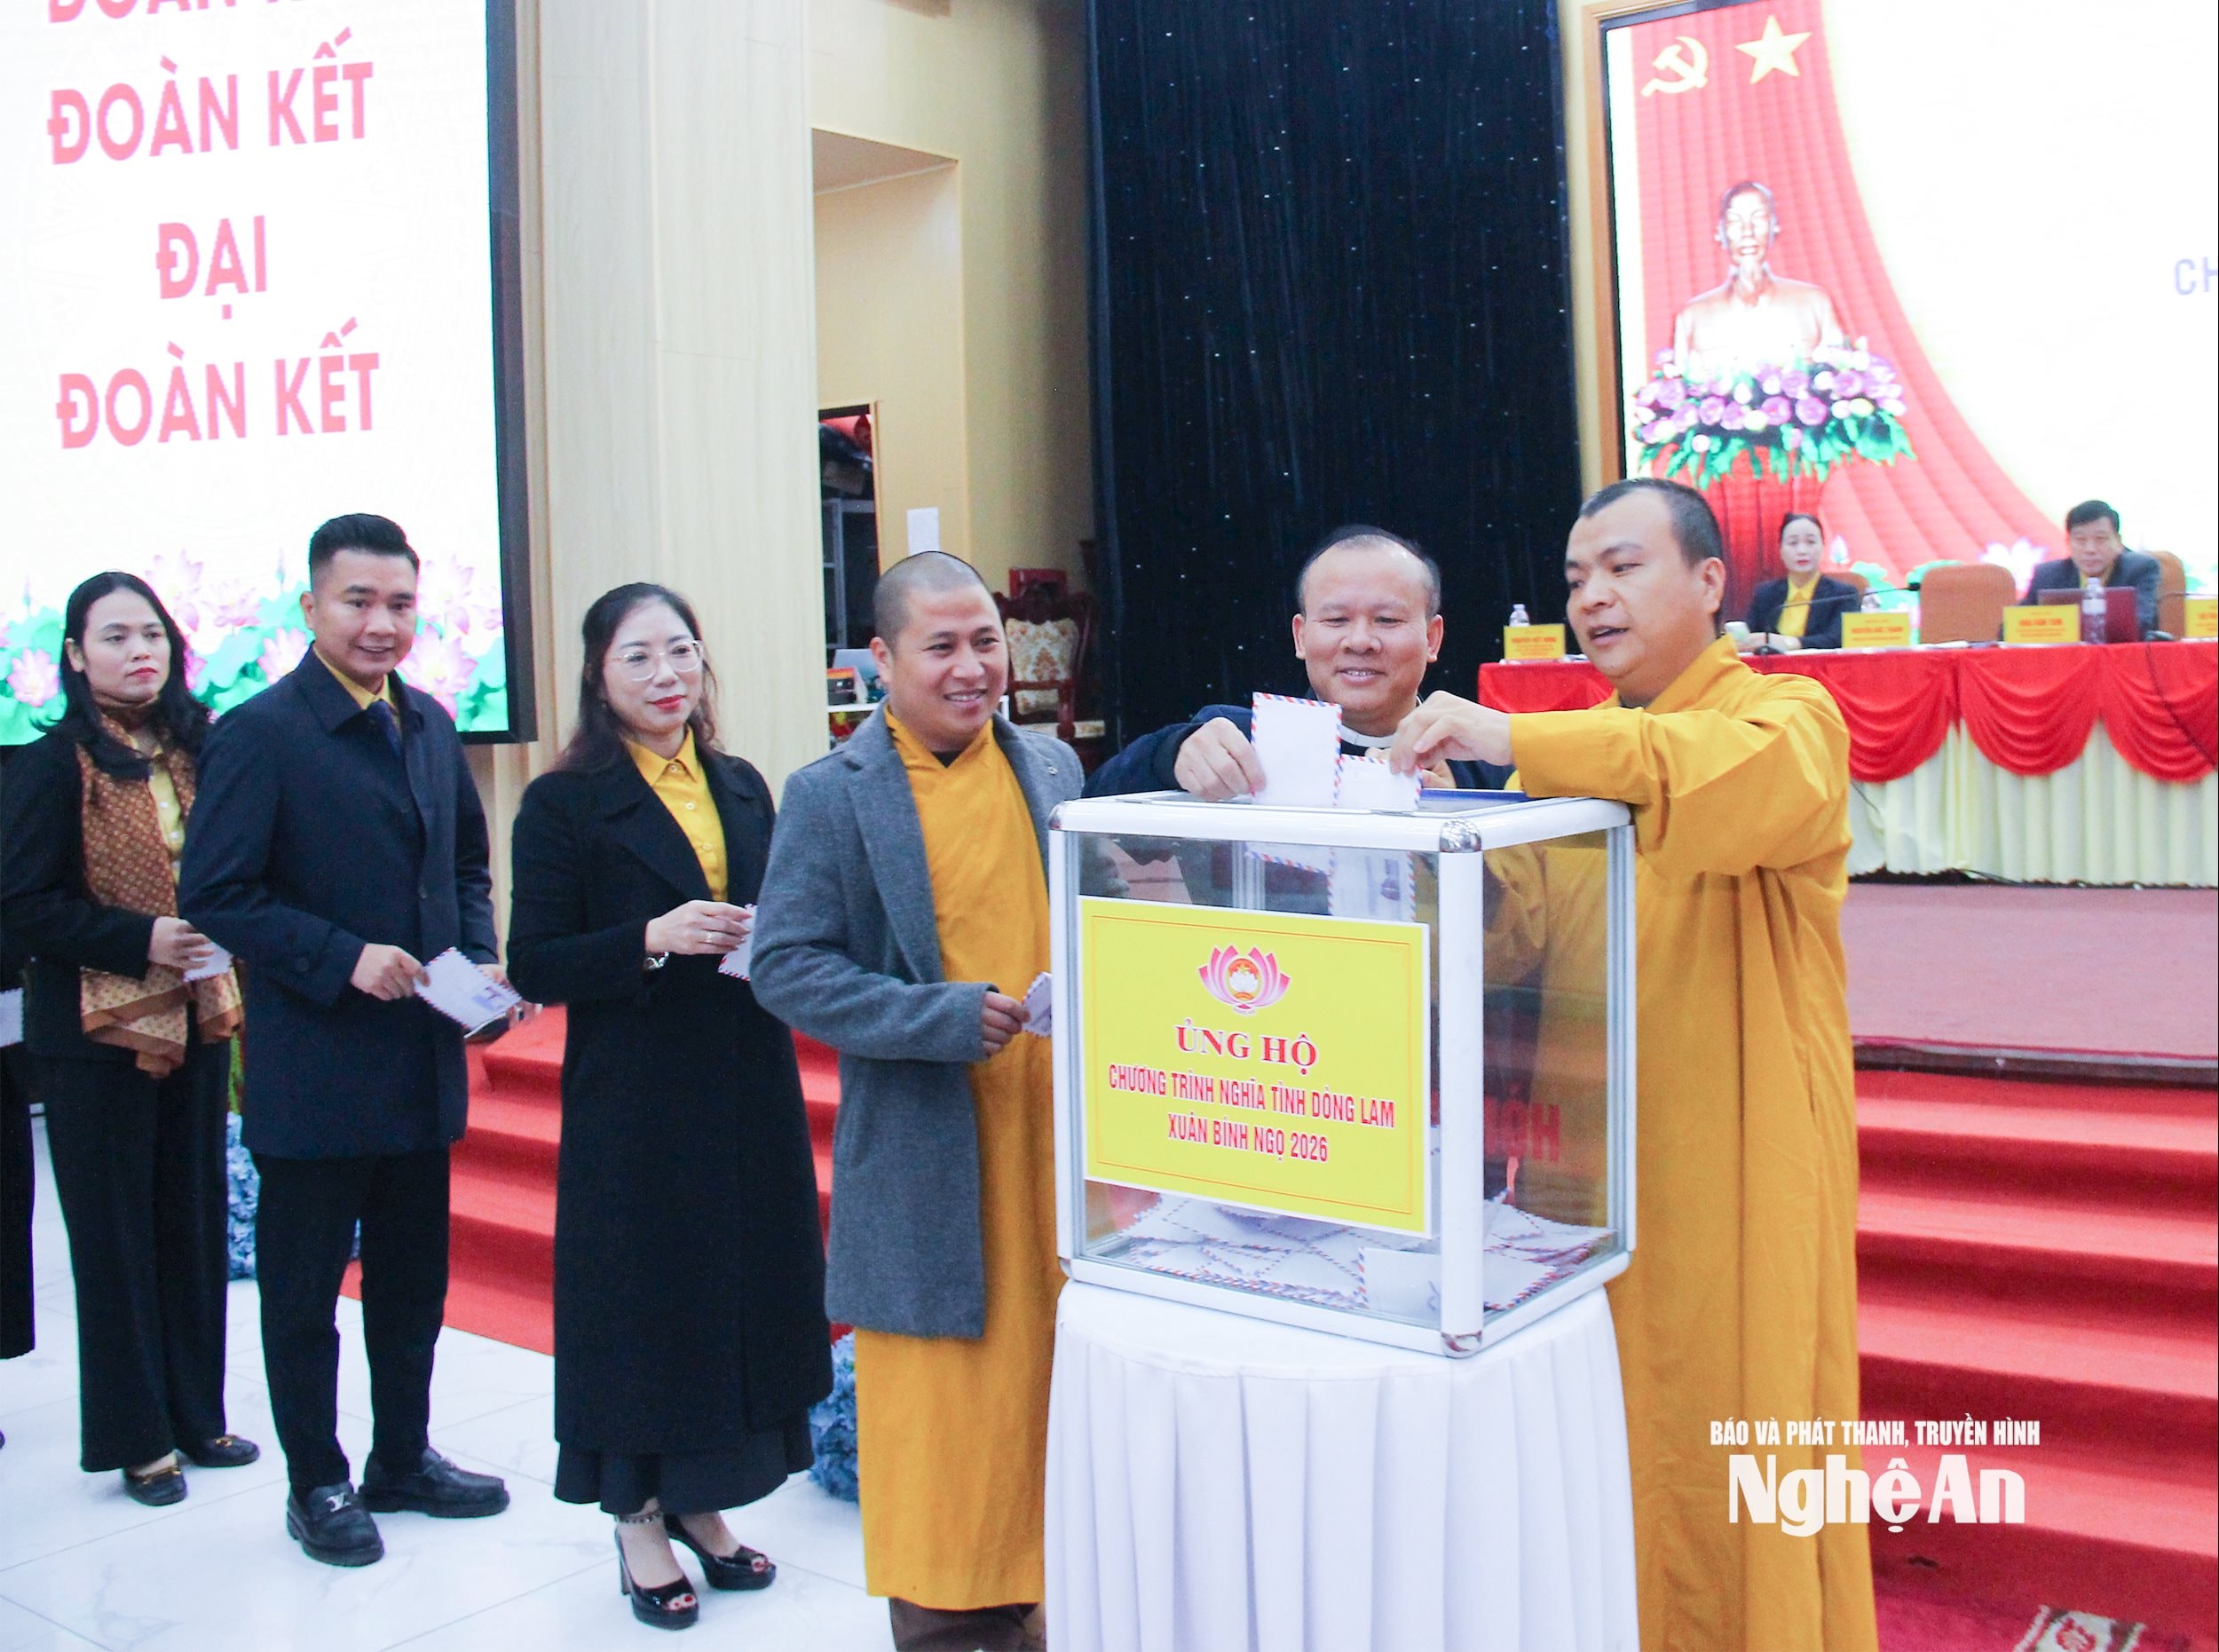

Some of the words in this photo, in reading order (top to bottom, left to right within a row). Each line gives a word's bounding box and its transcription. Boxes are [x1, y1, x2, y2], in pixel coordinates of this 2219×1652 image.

[47, 55, 239, 164] ĐOÀN
[267, 27, 374, 146] KẾT
[155, 215, 266, 320] ĐẠI
[56, 341, 247, 449] ĐOÀN
[274, 316, 380, 436] KẾT
[1174, 1018, 1251, 1058] ỦNG
[1261, 1033, 1316, 1075] HỘ
[1109, 1063, 1166, 1095] CHƯƠNG
[1171, 1069, 1214, 1103] TRÌNH
[1220, 1078, 1266, 1111] NGHĨA
[1271, 1080, 1306, 1116] TÌNH
[1361, 1097, 1394, 1128] LAM
[1168, 1111, 1208, 1144] XUÂN
[1254, 1126, 1284, 1161] NGỌ
[1291, 1132, 1328, 1163] 2026
